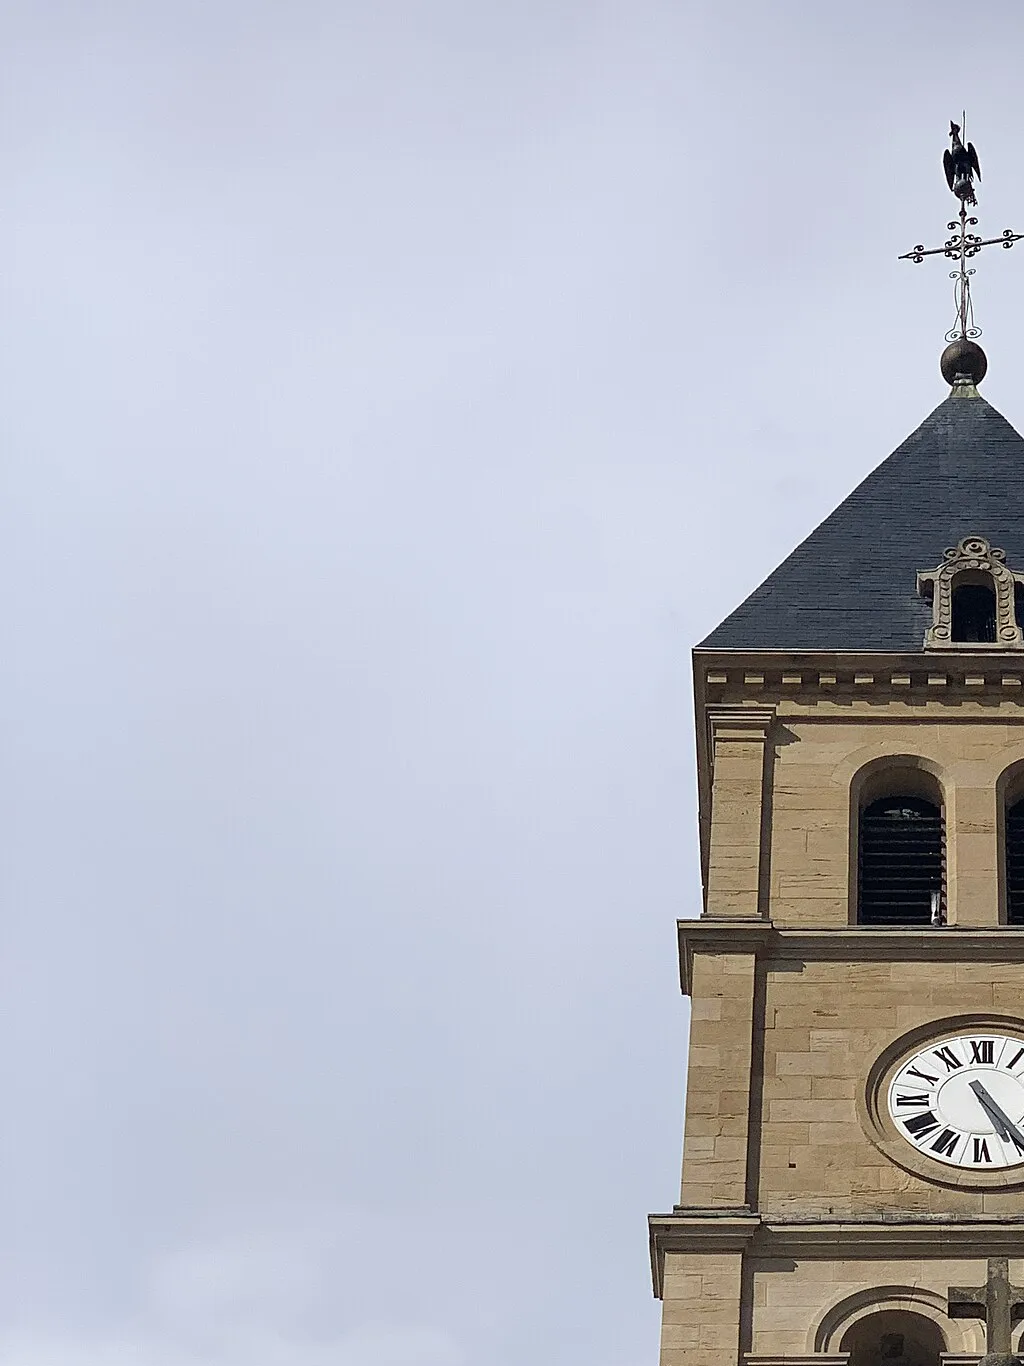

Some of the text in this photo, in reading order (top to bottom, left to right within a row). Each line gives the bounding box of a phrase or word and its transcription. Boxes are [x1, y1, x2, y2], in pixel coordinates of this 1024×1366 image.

[932, 1045, 964, 1073] XI
[969, 1040, 995, 1065] XII
[906, 1065, 940, 1086] X
[896, 1093, 930, 1107] IX
[929, 1128, 962, 1158] VII
[973, 1138, 993, 1163] VI
